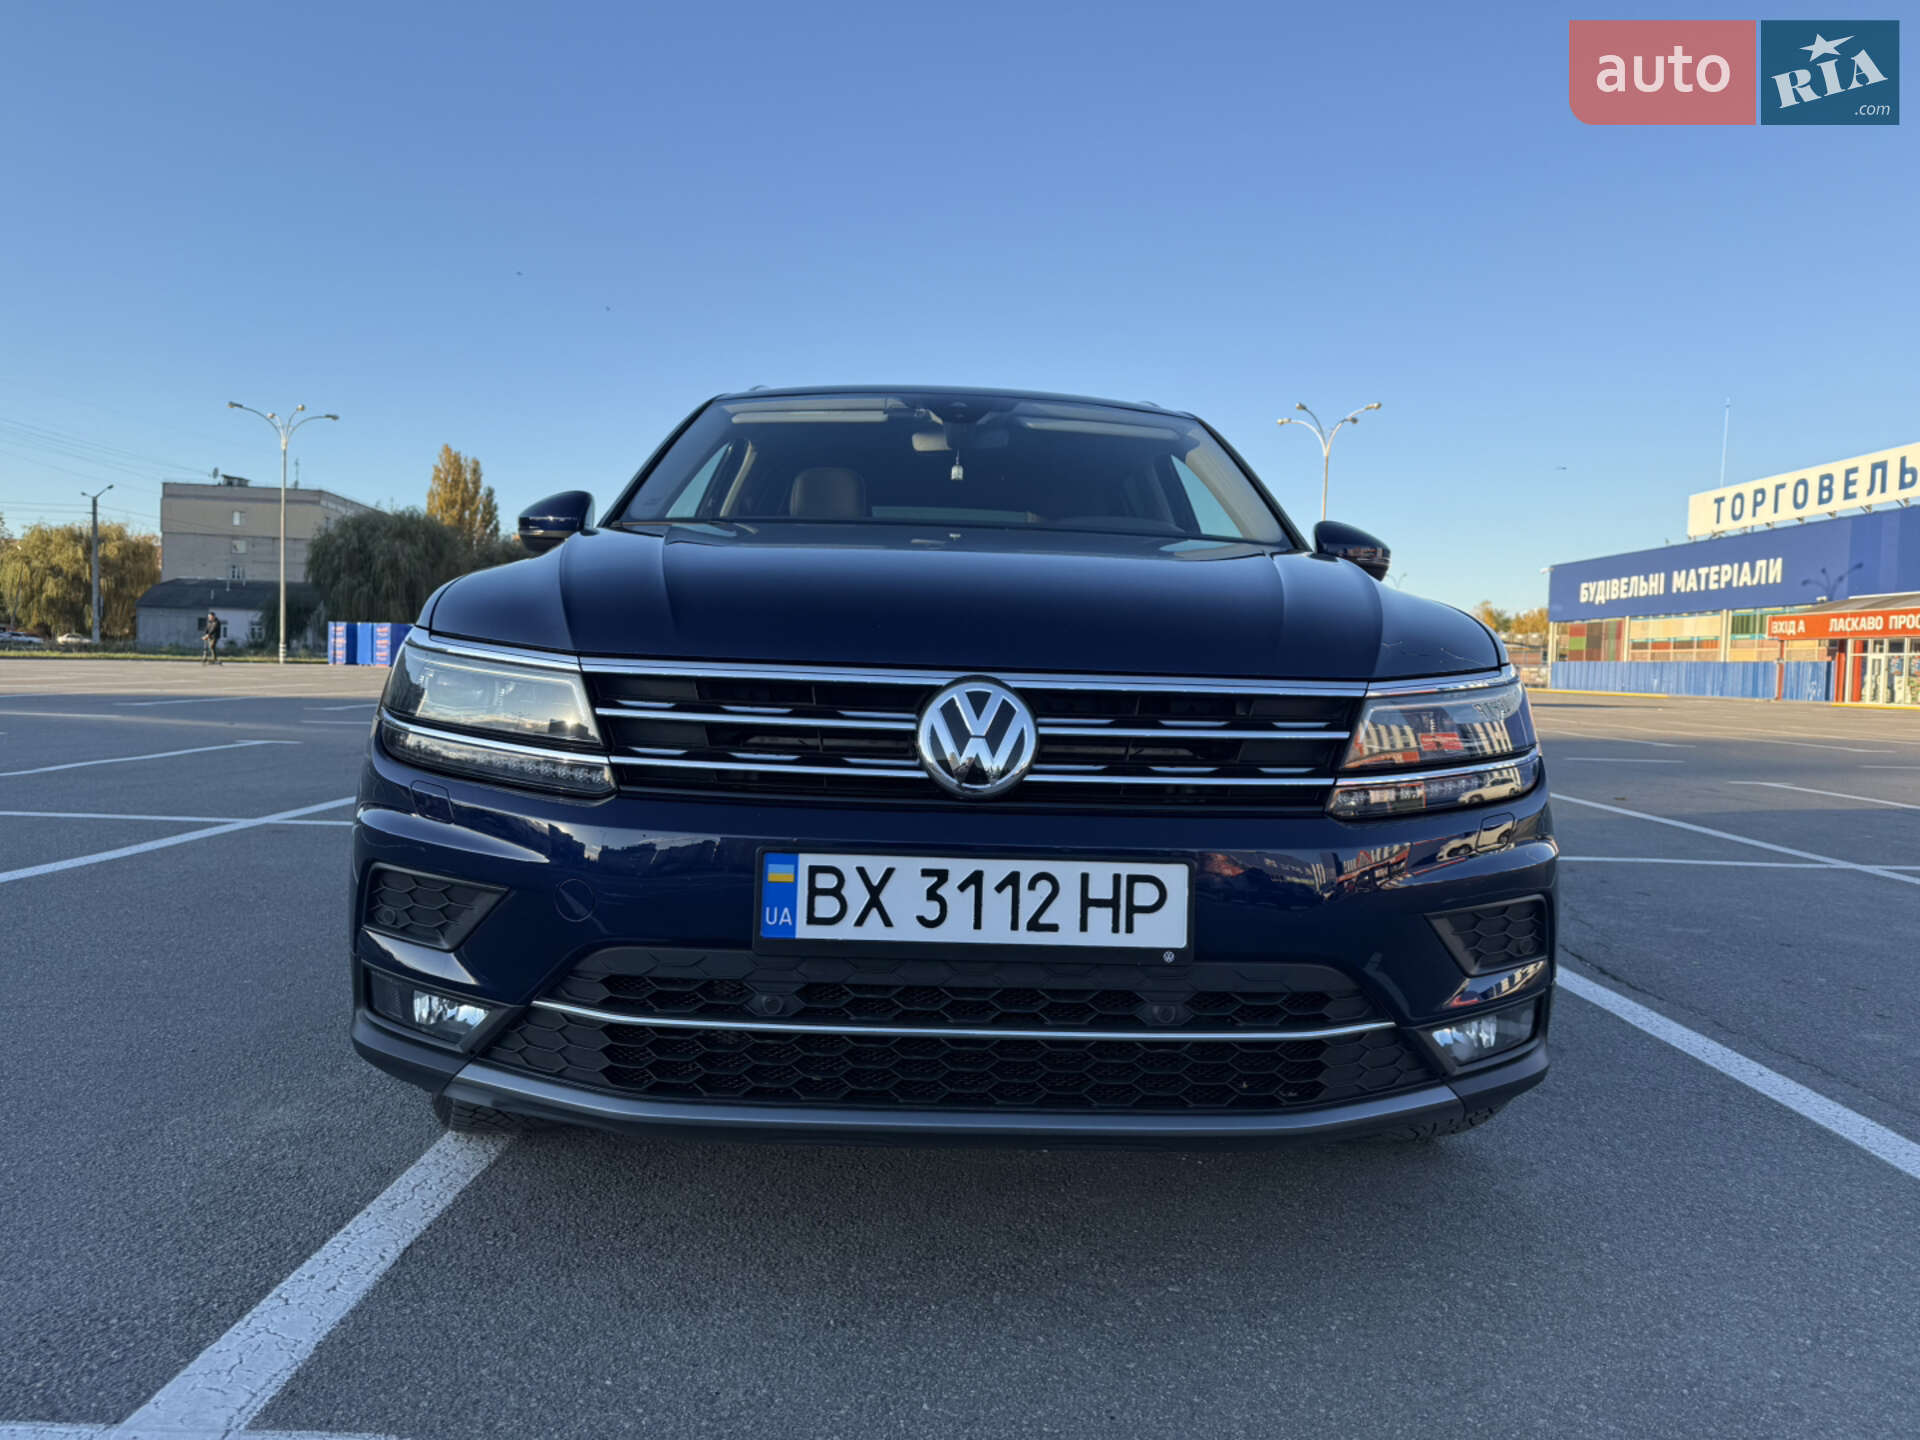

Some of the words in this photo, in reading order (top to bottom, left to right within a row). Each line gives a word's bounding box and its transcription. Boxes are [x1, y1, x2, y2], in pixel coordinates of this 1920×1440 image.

[1714, 456, 1919, 525] ТОРГОВЕЛЬ
[1579, 572, 1665, 605] БУДІВЕЛЬНІ
[1671, 557, 1783, 593] МАТЕРІАЛИ
[1771, 621, 1796, 635] ВХІД
[1828, 616, 1884, 632] ЛАСКАВО
[765, 906, 793, 926] UA
[806, 864, 896, 928] BX
[915, 868, 1061, 933] 3112
[1079, 872, 1169, 935] HP
